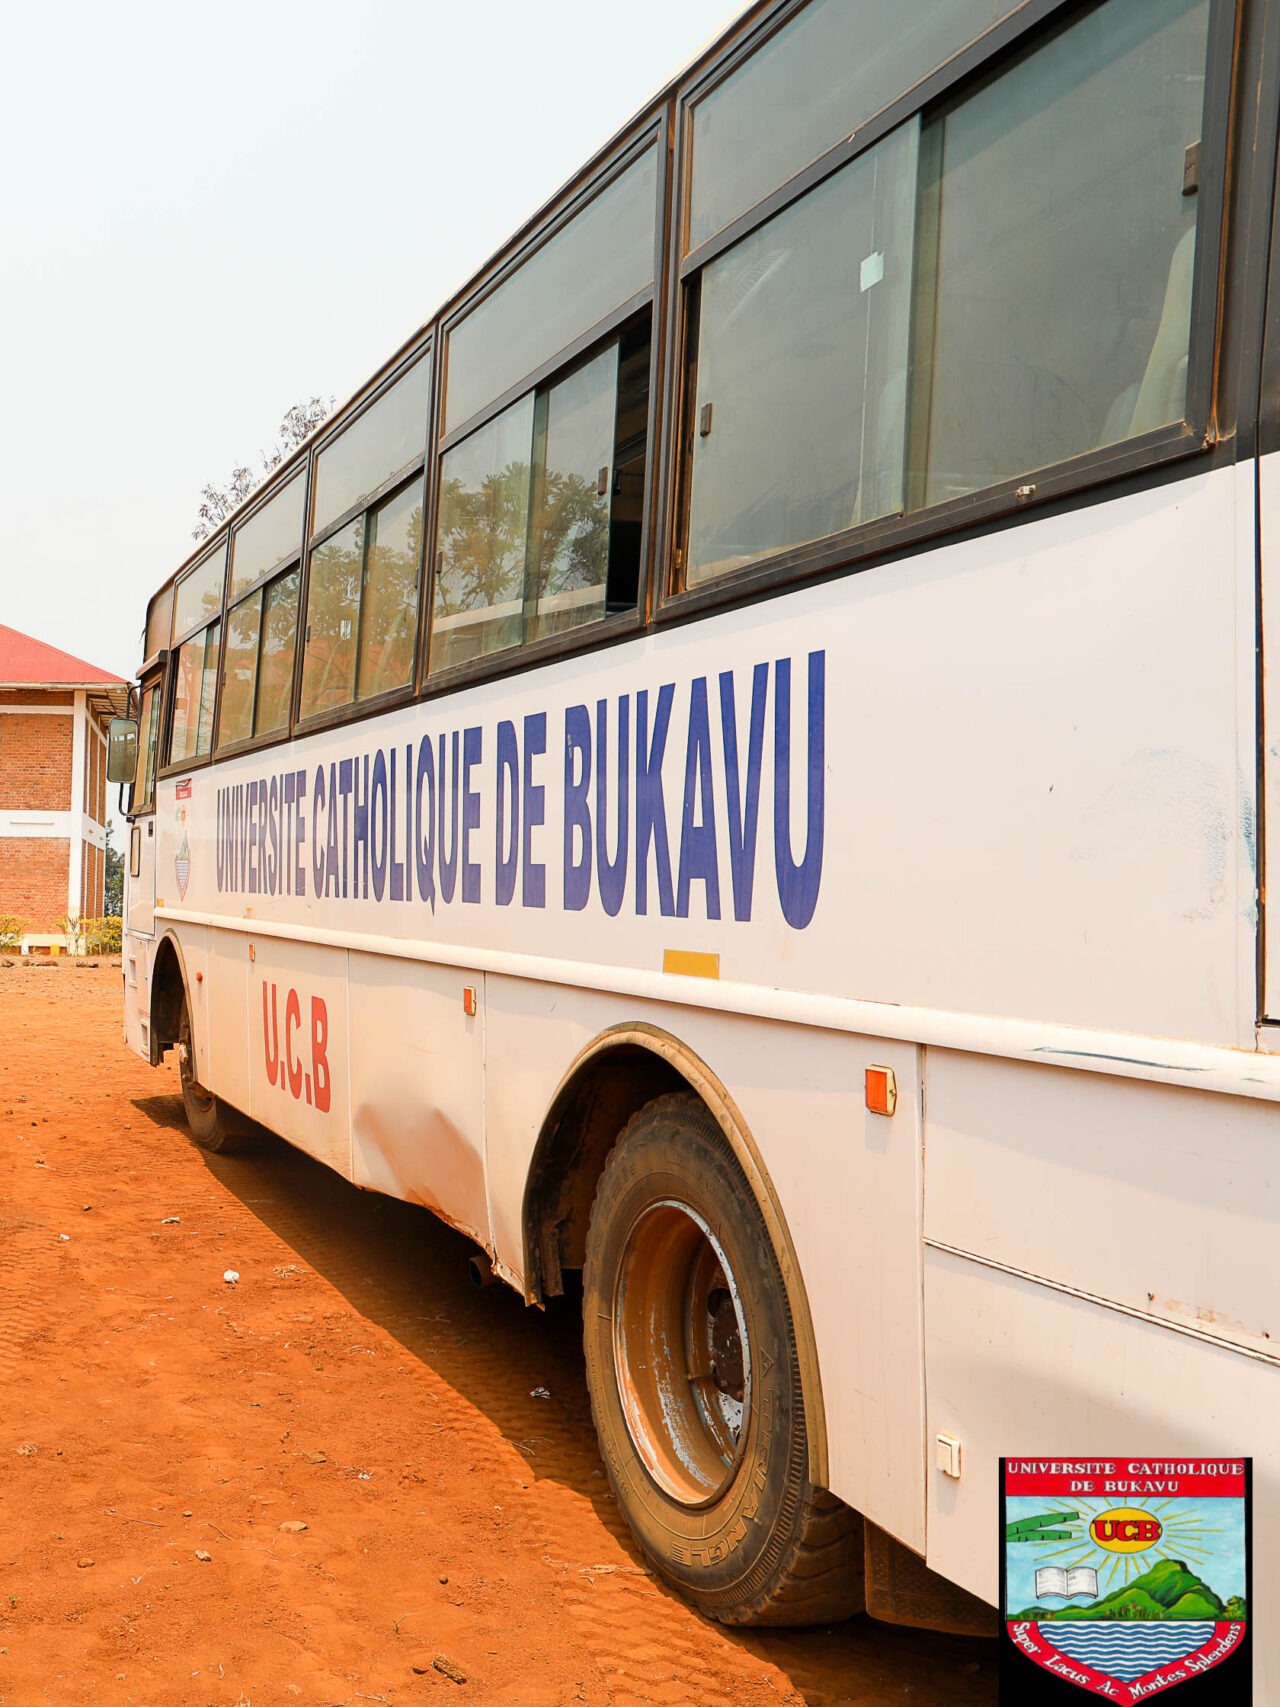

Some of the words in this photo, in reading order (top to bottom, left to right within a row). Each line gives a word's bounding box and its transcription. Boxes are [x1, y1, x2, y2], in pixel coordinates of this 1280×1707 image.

[216, 769, 307, 896] UNIVERSITE
[312, 725, 483, 917] CATHOLIQUE
[495, 711, 547, 909] DE
[563, 649, 826, 930] BUKAVU
[262, 980, 331, 1113] U.C.B
